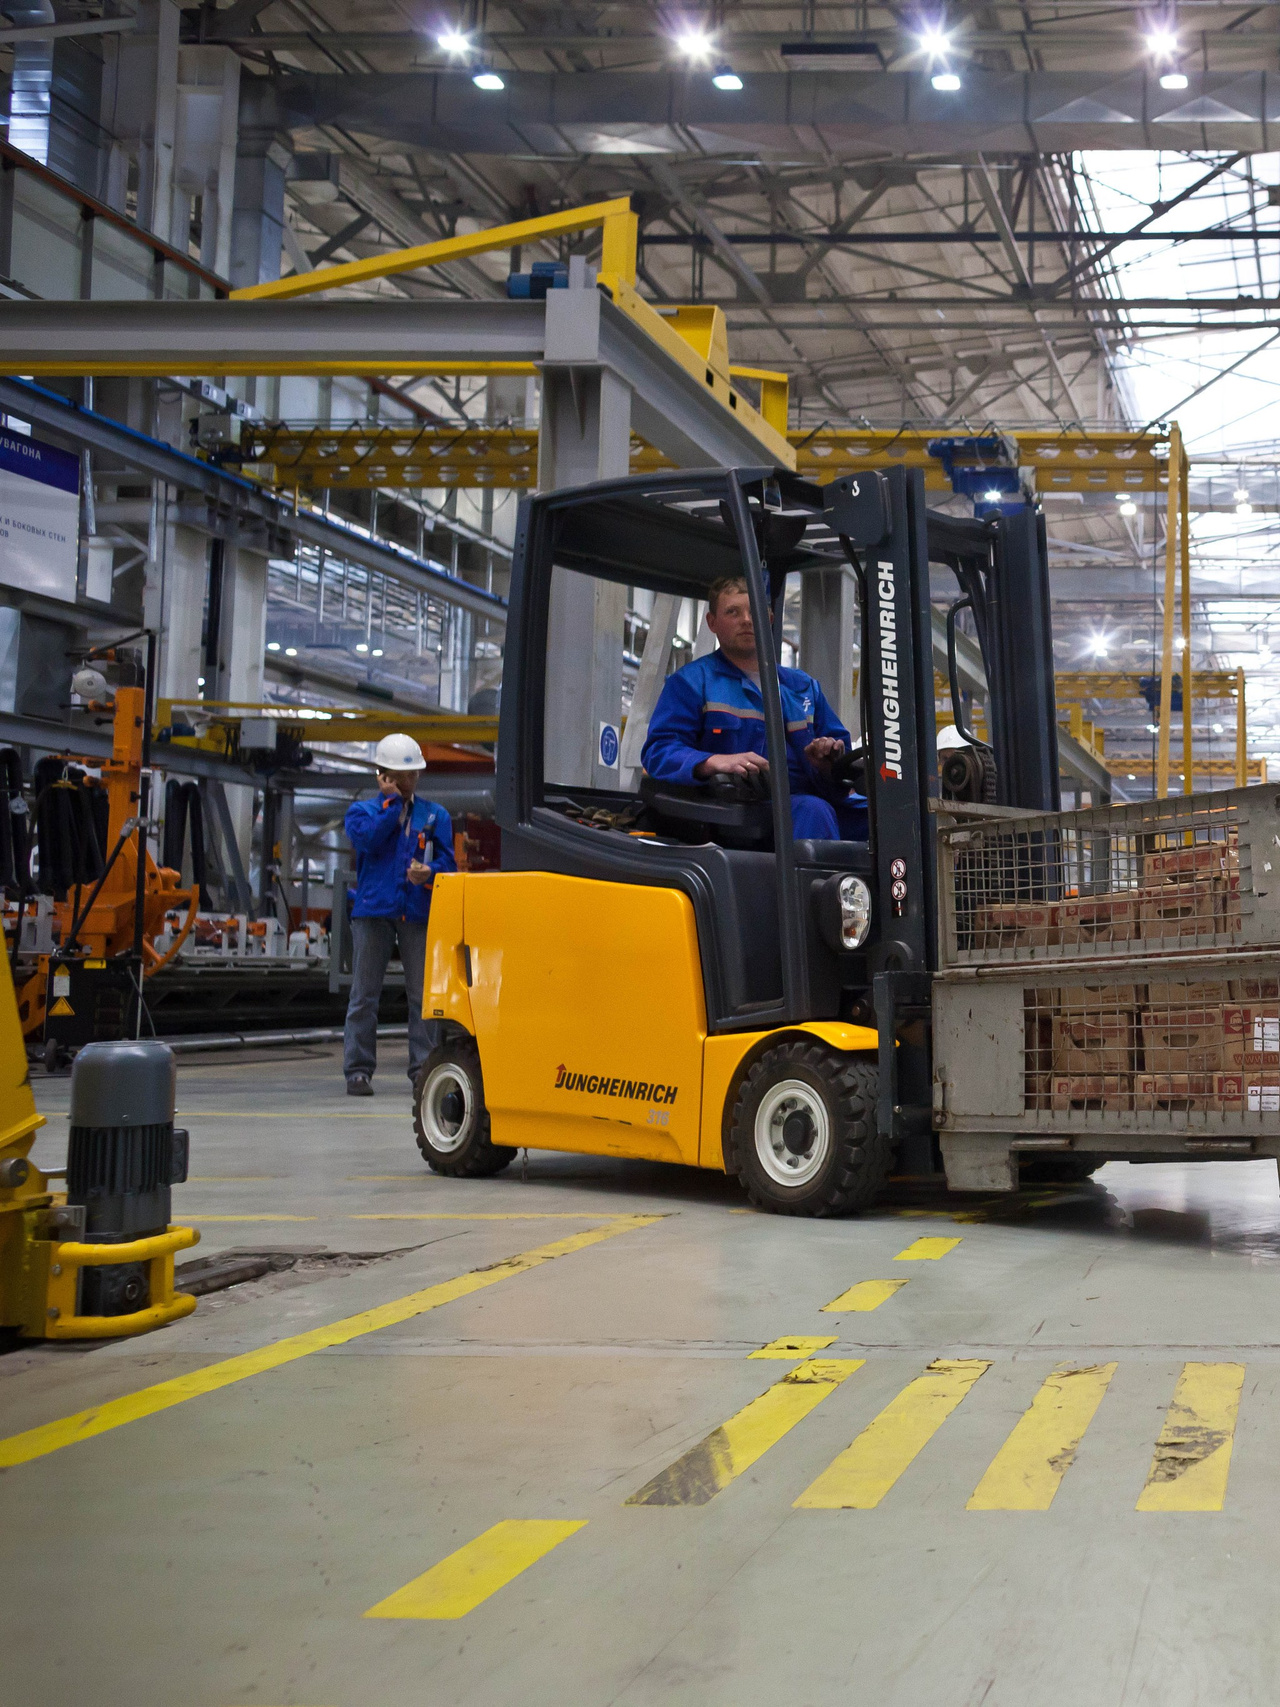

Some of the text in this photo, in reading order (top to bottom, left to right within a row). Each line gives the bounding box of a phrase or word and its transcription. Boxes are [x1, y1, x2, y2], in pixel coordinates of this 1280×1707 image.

[12, 520, 46, 537] БОКОВЫХ
[48, 531, 66, 543] СТЕН
[877, 561, 903, 780] JUNGHEINRICH
[554, 1070, 678, 1104] JUNGHEINRICH
[646, 1108, 670, 1126] 316
